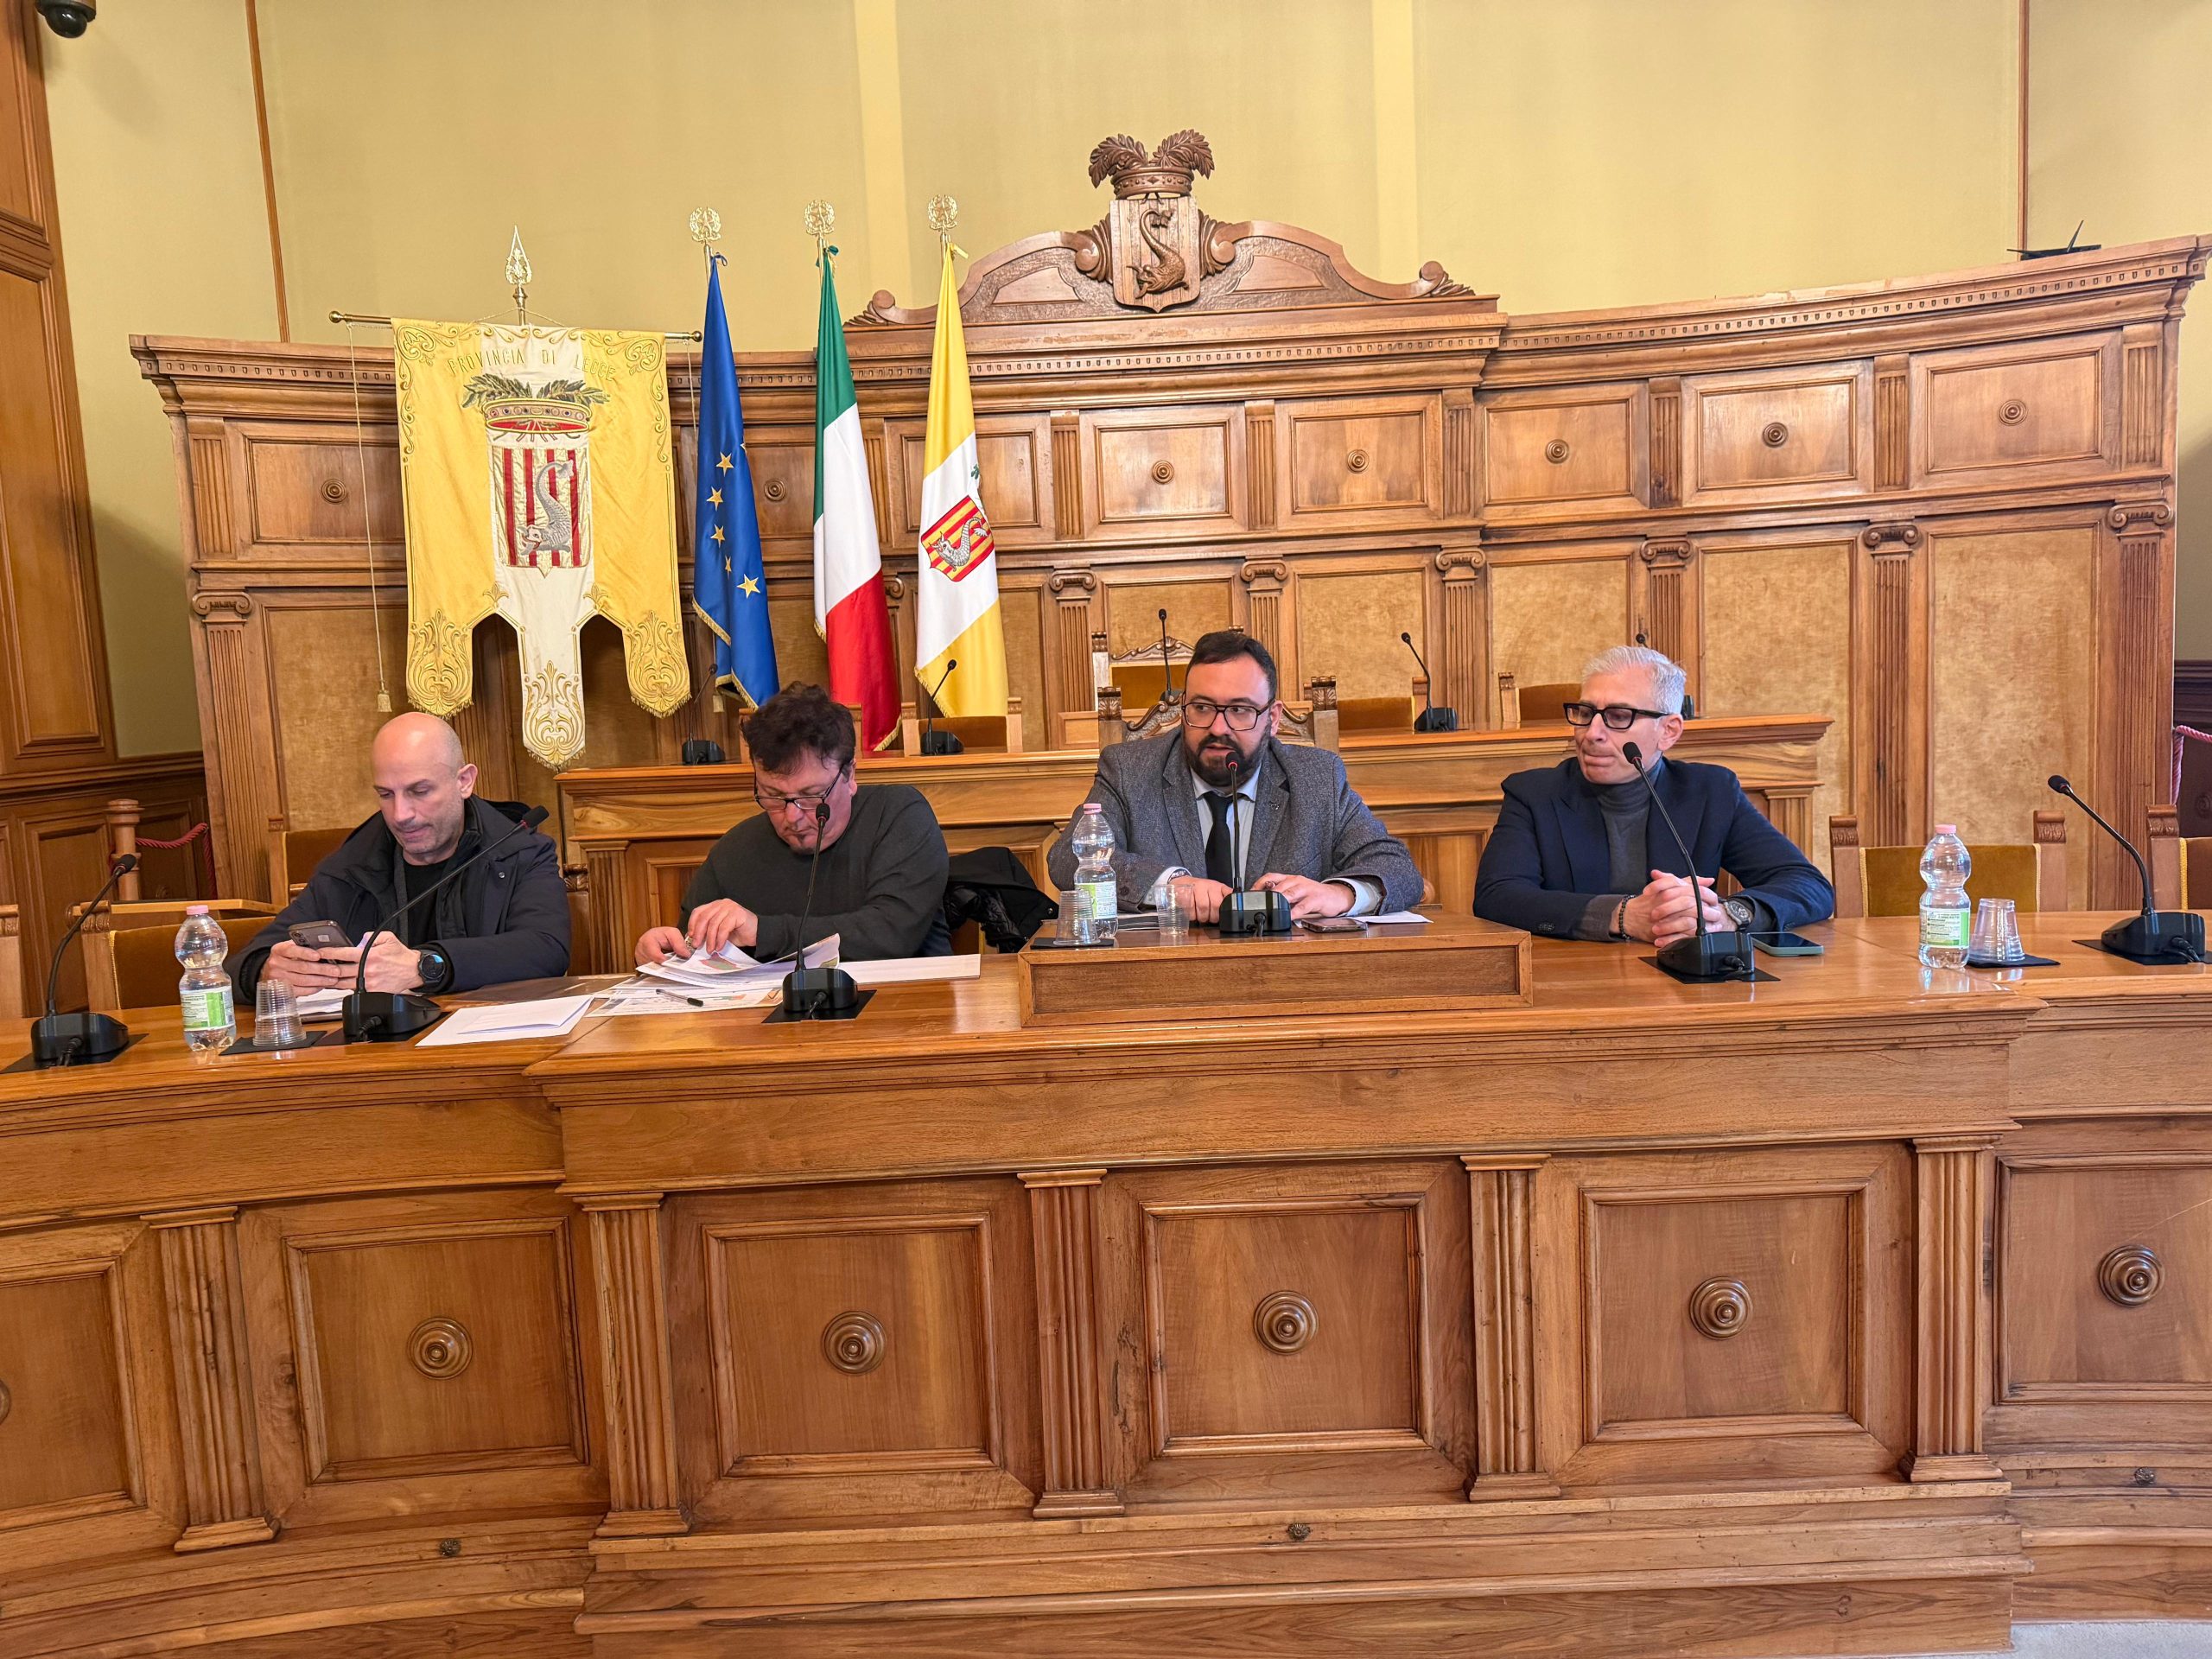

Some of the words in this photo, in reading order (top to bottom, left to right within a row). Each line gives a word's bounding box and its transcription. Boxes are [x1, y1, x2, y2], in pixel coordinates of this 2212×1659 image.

[447, 348, 524, 374] PROVINCIA
[542, 349, 556, 365] DI
[574, 354, 616, 381] LECCE
